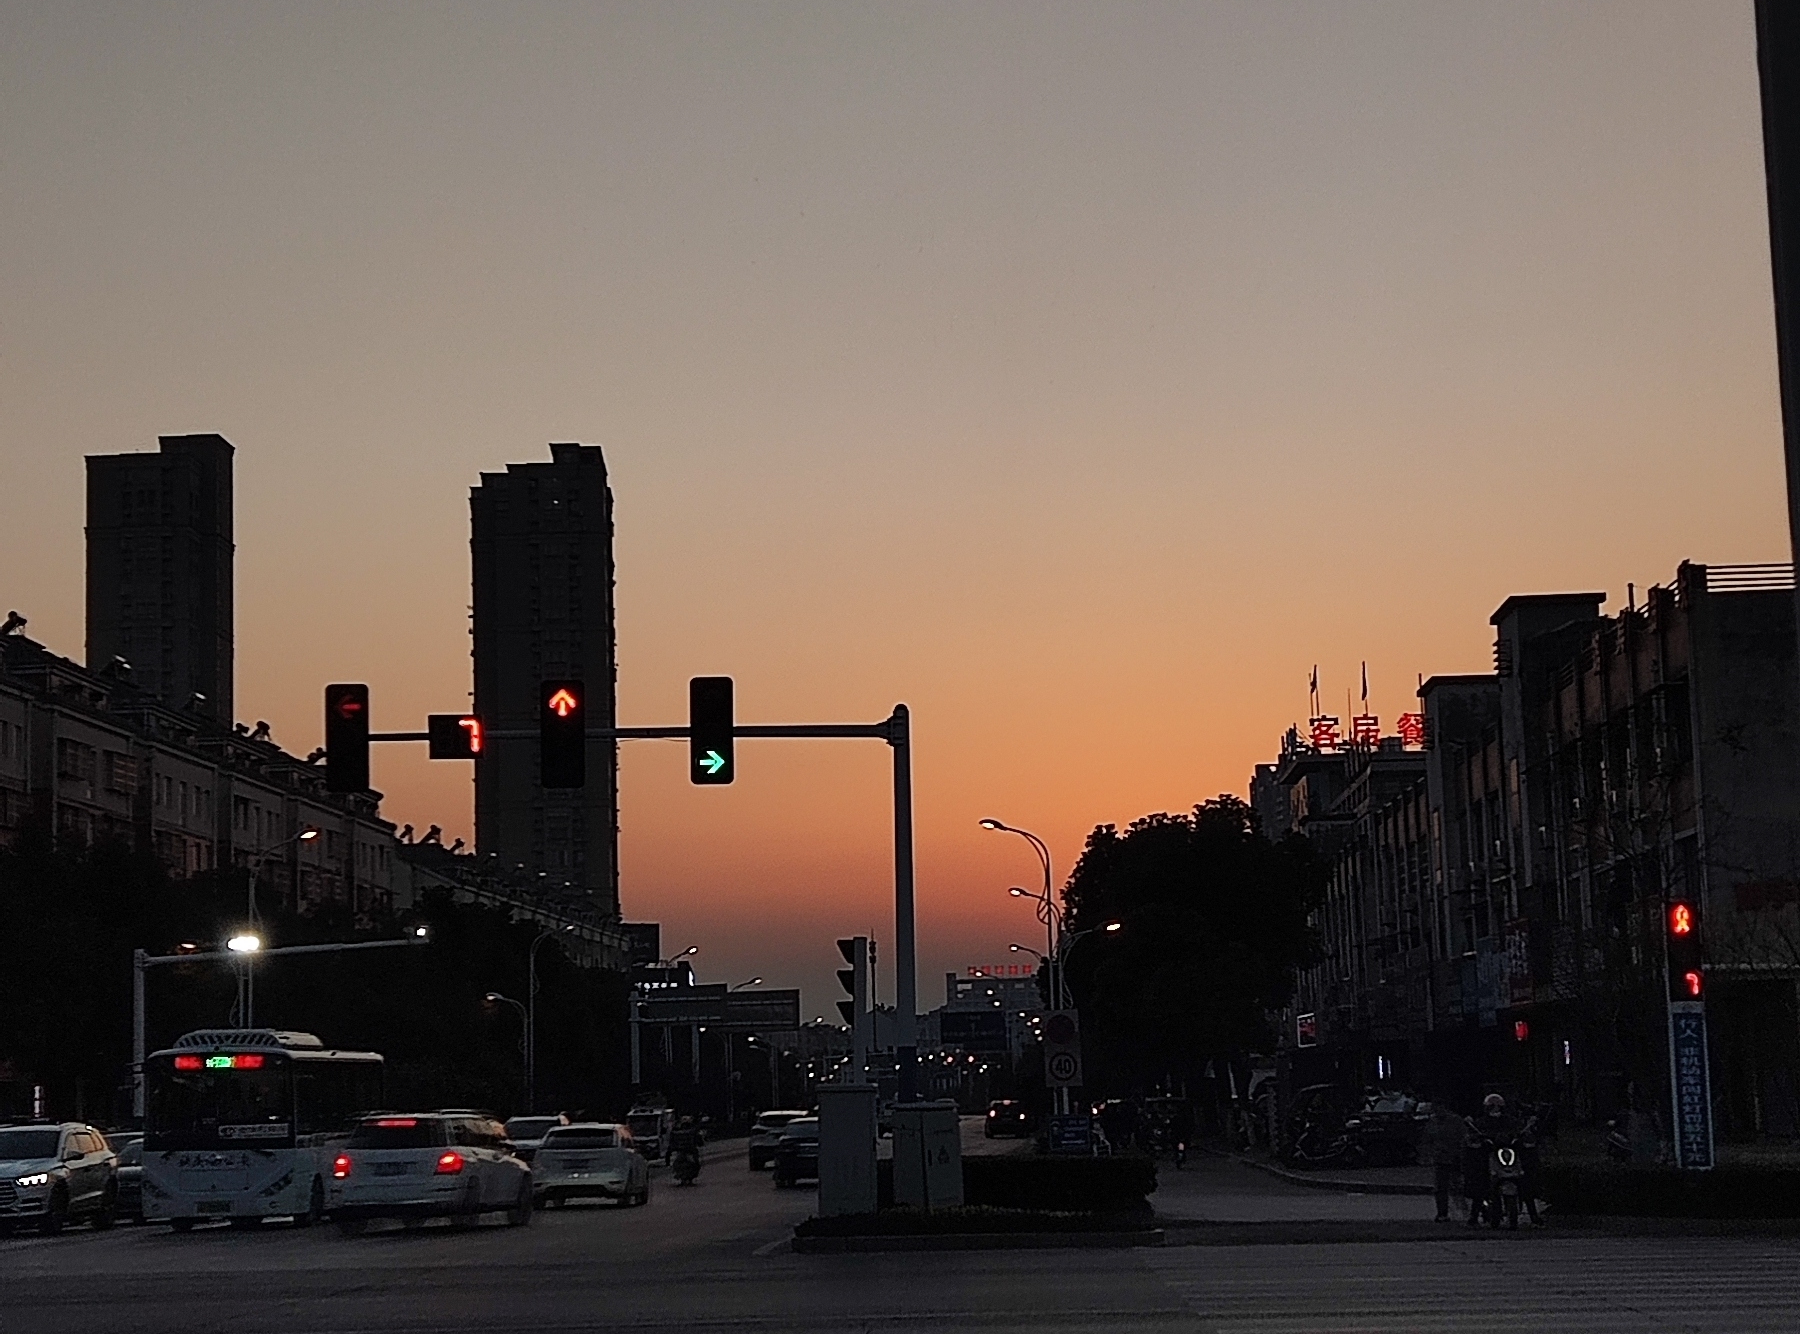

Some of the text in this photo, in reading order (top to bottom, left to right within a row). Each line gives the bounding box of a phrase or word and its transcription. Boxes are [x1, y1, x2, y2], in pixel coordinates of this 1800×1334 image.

[458, 719, 480, 753] 7
[1685, 972, 1699, 995] 7
[1055, 1058, 1072, 1075] 40
